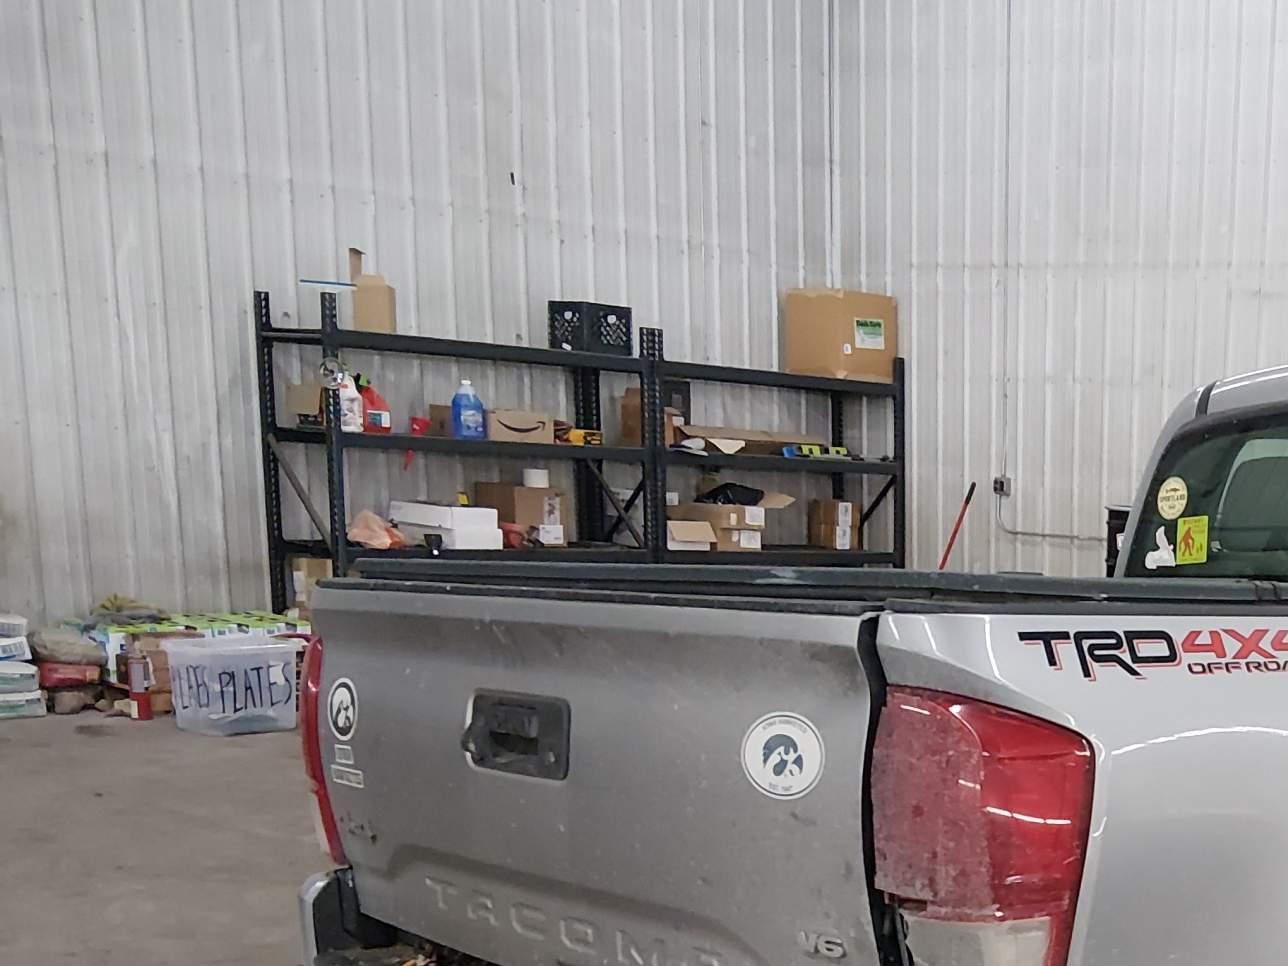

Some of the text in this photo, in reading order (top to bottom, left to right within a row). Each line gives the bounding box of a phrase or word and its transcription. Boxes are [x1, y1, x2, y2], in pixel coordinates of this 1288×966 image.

[1017, 630, 1182, 680] TRD
[218, 662, 293, 714] PLATES
[799, 929, 849, 961] V6
